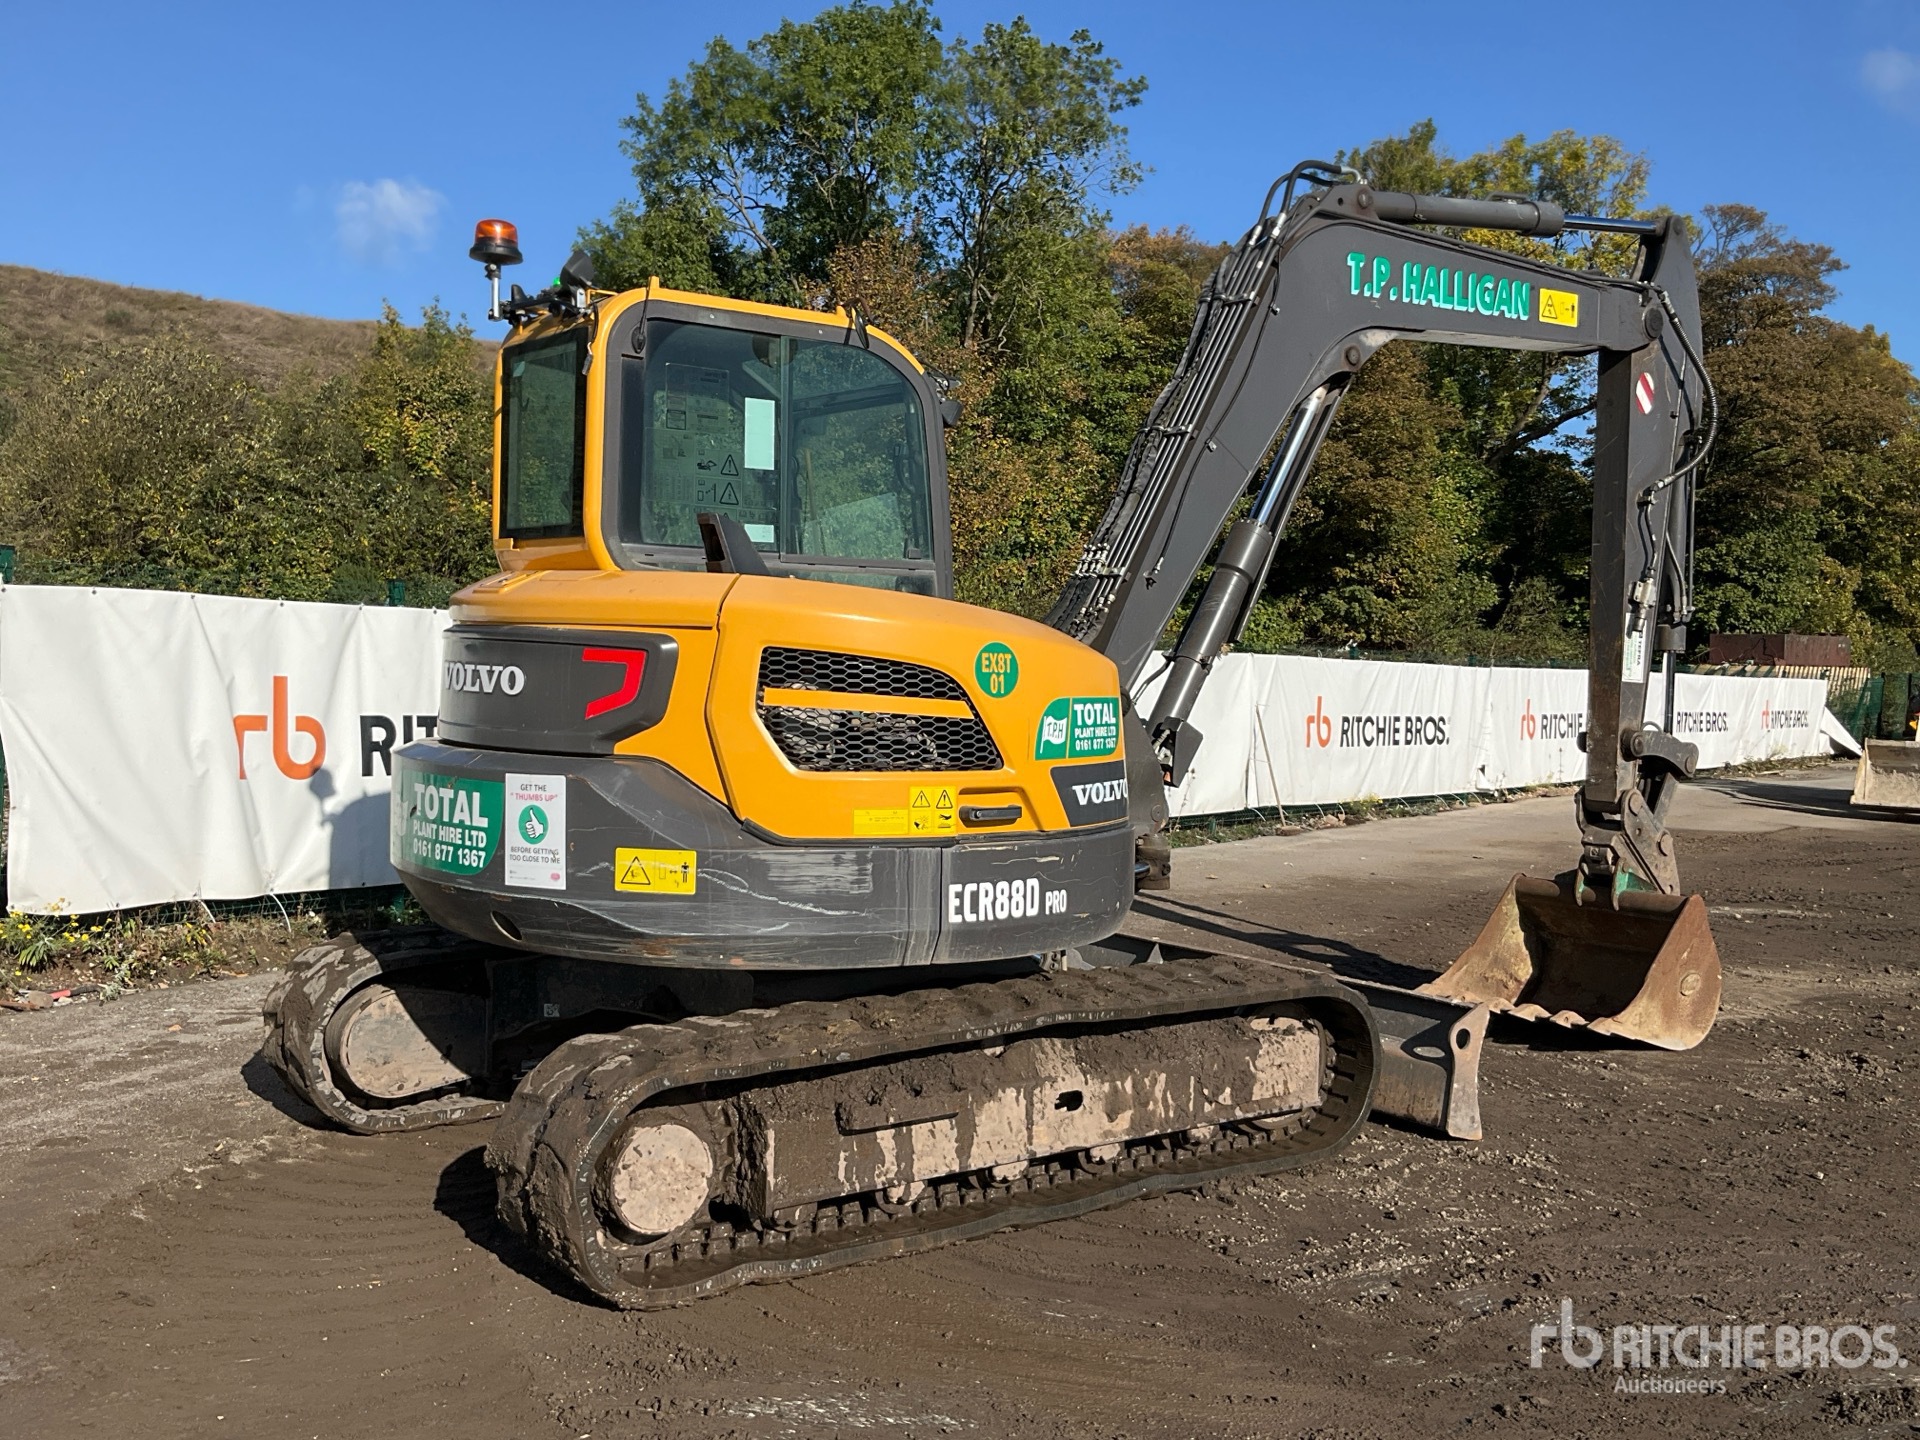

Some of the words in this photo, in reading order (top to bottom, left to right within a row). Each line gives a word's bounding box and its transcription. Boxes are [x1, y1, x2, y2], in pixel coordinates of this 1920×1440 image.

[1347, 253, 1398, 301] T.P.
[1402, 261, 1530, 320] HALLIGAN
[981, 653, 1011, 673] EX8T
[444, 662, 525, 695] VOLVO
[990, 673, 1005, 694] 01
[233, 676, 326, 780] rb
[1074, 703, 1116, 726] TOTAL
[1306, 696, 1331, 748] rb
[1340, 716, 1401, 747] RITCHIE
[1404, 716, 1450, 746] BROS.
[1520, 699, 1536, 740] rb
[1540, 713, 1583, 739] RITCHIE
[1676, 711, 1704, 733] RITCHIE
[1074, 727, 1094, 739] PLANT
[1095, 726, 1108, 737] HIRE
[1108, 725, 1117, 736] LTD
[1075, 739, 1092, 751] 0161
[1093, 738, 1104, 750] 877
[1105, 737, 1116, 749] 1367
[534, 784, 547, 792] THE
[1072, 777, 1128, 805] VOLVO
[414, 783, 489, 828] TOTAL
[413, 819, 437, 840] PLANT
[439, 825, 462, 845] HIRE
[465, 829, 487, 848] LTD
[413, 837, 432, 858] 0161
[435, 843, 454, 862] 877
[457, 848, 486, 868] 1367
[510, 846, 531, 854] BEFORE
[522, 855, 540, 863] CLOSE
[948, 877, 1040, 923] ECR88D
[1045, 889, 1067, 915] PRO
